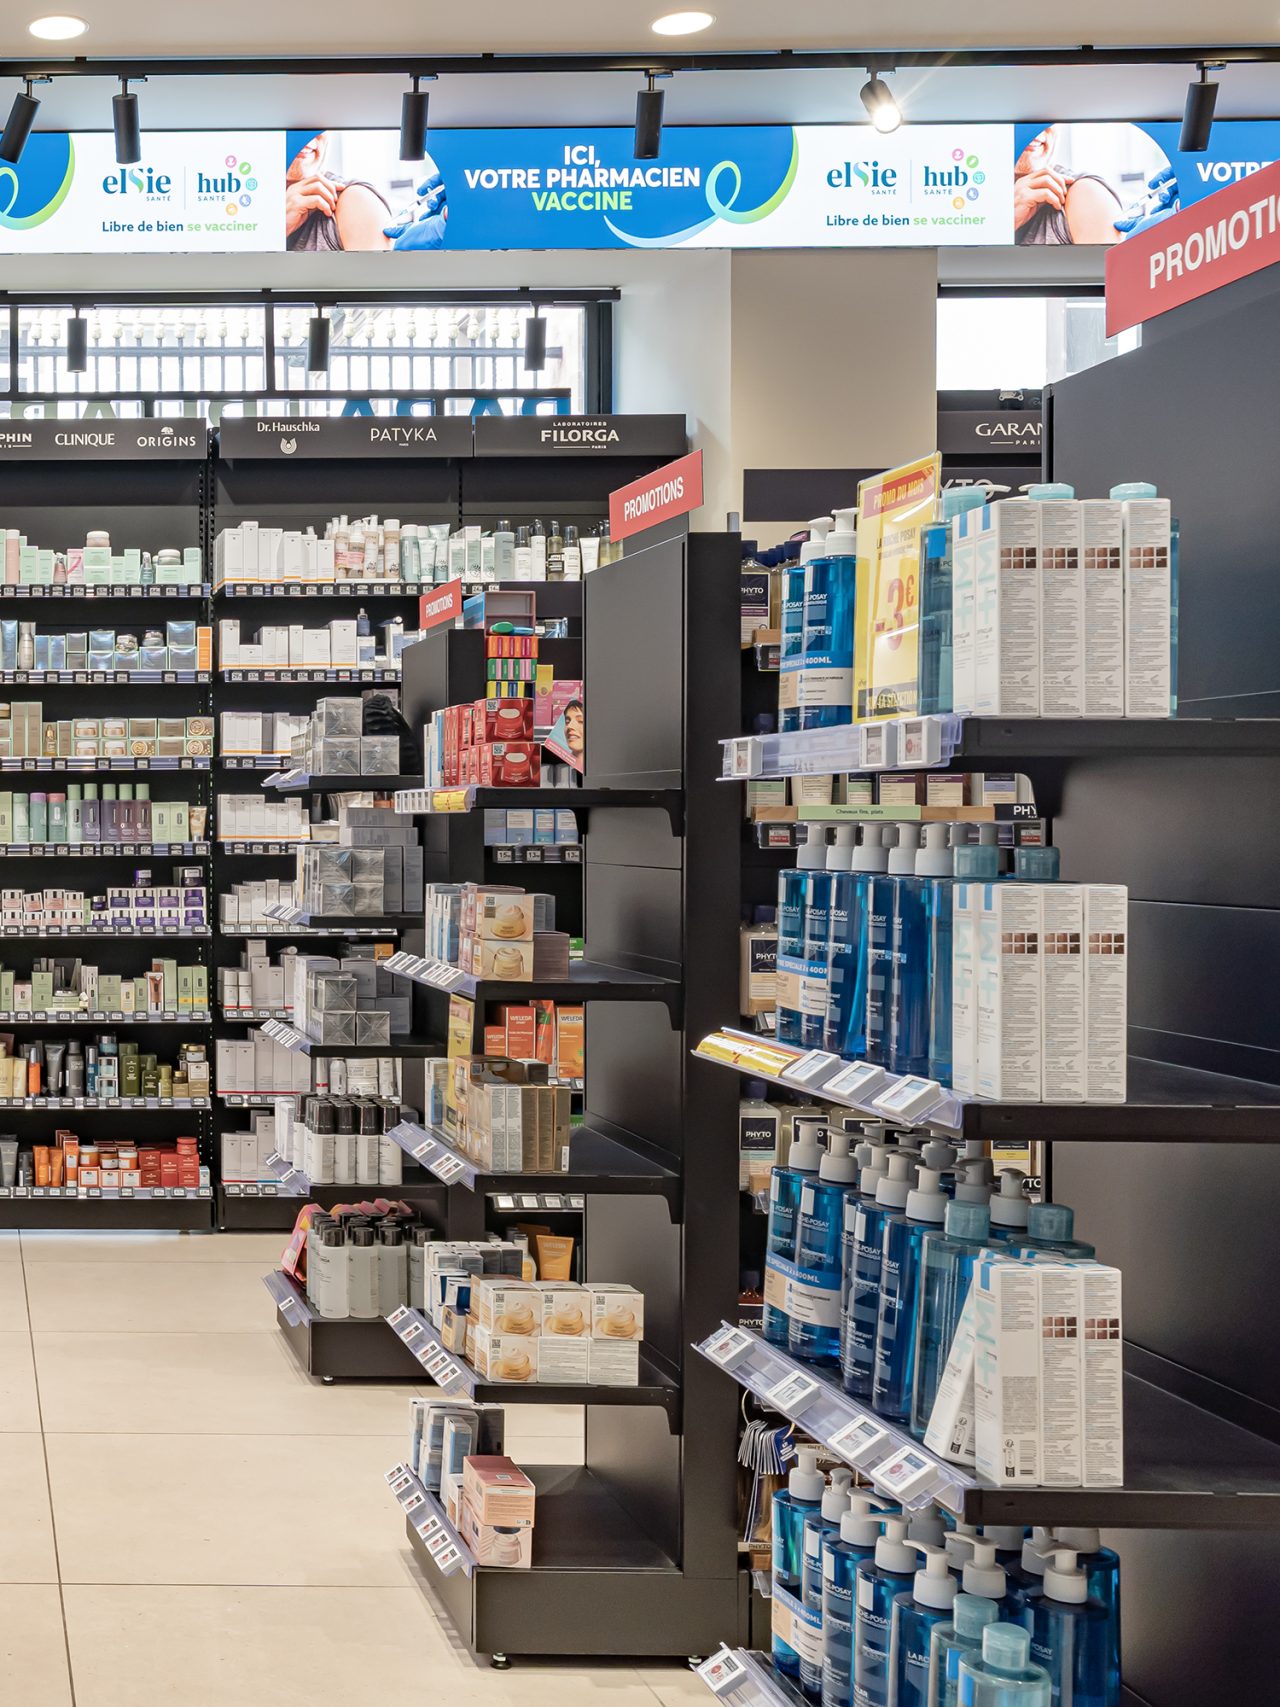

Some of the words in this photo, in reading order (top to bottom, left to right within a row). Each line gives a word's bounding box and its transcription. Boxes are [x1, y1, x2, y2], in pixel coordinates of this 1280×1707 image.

[564, 145, 600, 168] ICI,
[198, 173, 241, 193] hub
[464, 169, 540, 189] VOTRE
[547, 168, 700, 188] PHARMACIEN
[924, 166, 968, 186] hub
[532, 191, 632, 211] VACCINE
[102, 222, 134, 232] Libre
[138, 221, 153, 232] de
[156, 221, 183, 231] bien
[187, 223, 201, 231] se
[205, 221, 258, 231] vacciner
[826, 215, 858, 226] Libre
[863, 215, 878, 226] de
[882, 214, 909, 225] bien
[914, 217, 927, 225] se
[931, 214, 986, 225] vacciner
[1150, 194, 1280, 289] PROMOTI
[55, 433, 115, 446] CLINIQUE
[137, 436, 196, 447] ORIGINS
[370, 428, 437, 441] PATYKA
[541, 429, 619, 442] FILORGA
[624, 476, 684, 522] PROMOTIONS
[873, 487, 896, 511] PROMO
[897, 485, 907, 502] DU
[425, 593, 453, 618] PROMOTIONS
[746, 1131, 771, 1139] PHYTO
